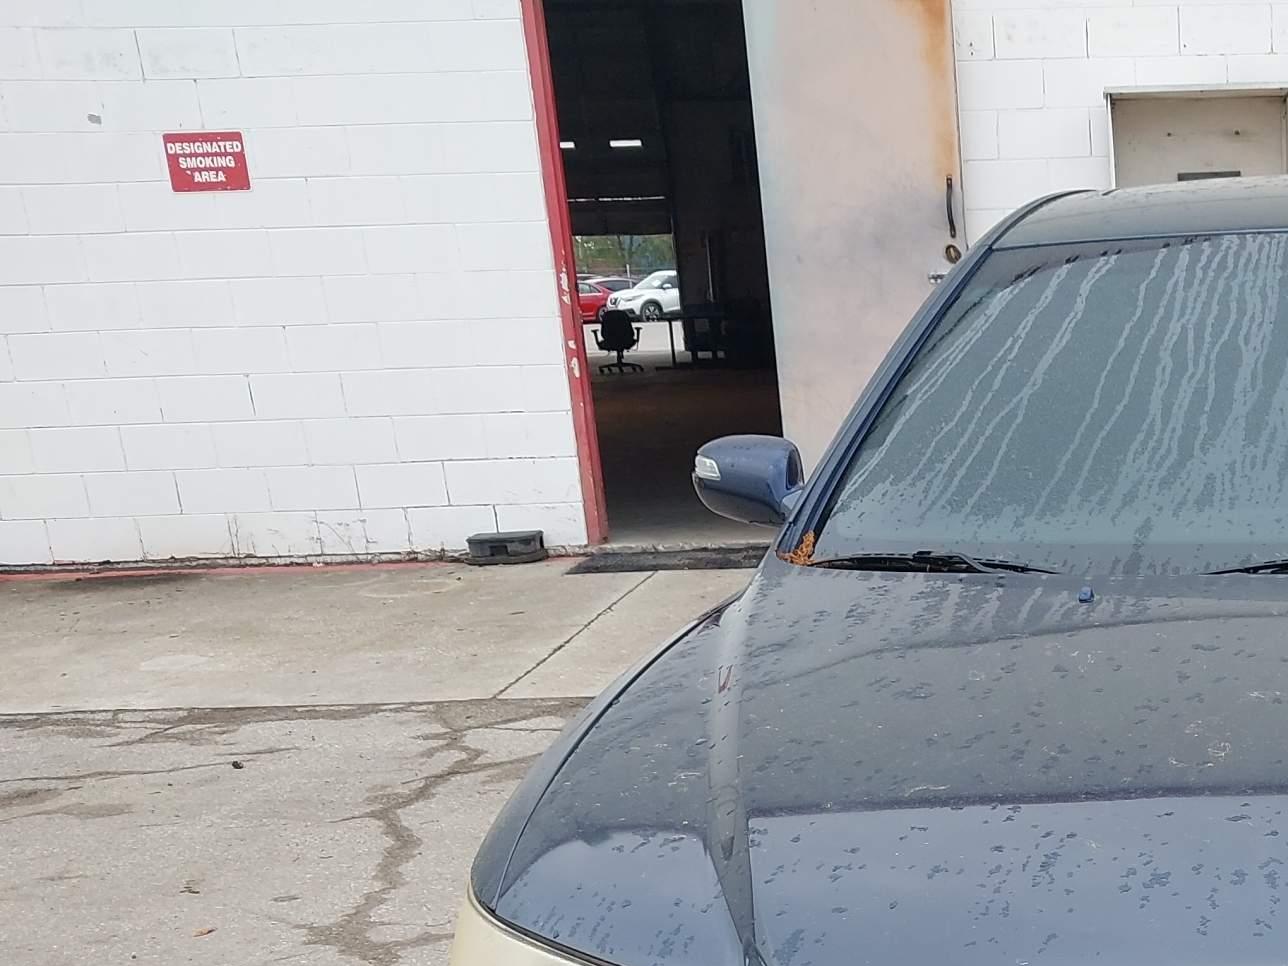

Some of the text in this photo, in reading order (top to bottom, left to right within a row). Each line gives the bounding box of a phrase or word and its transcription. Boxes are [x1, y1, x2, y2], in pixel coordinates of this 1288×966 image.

[166, 141, 242, 154] DESIGNATED
[178, 155, 235, 169] SMOKING
[193, 170, 226, 183] AREA
